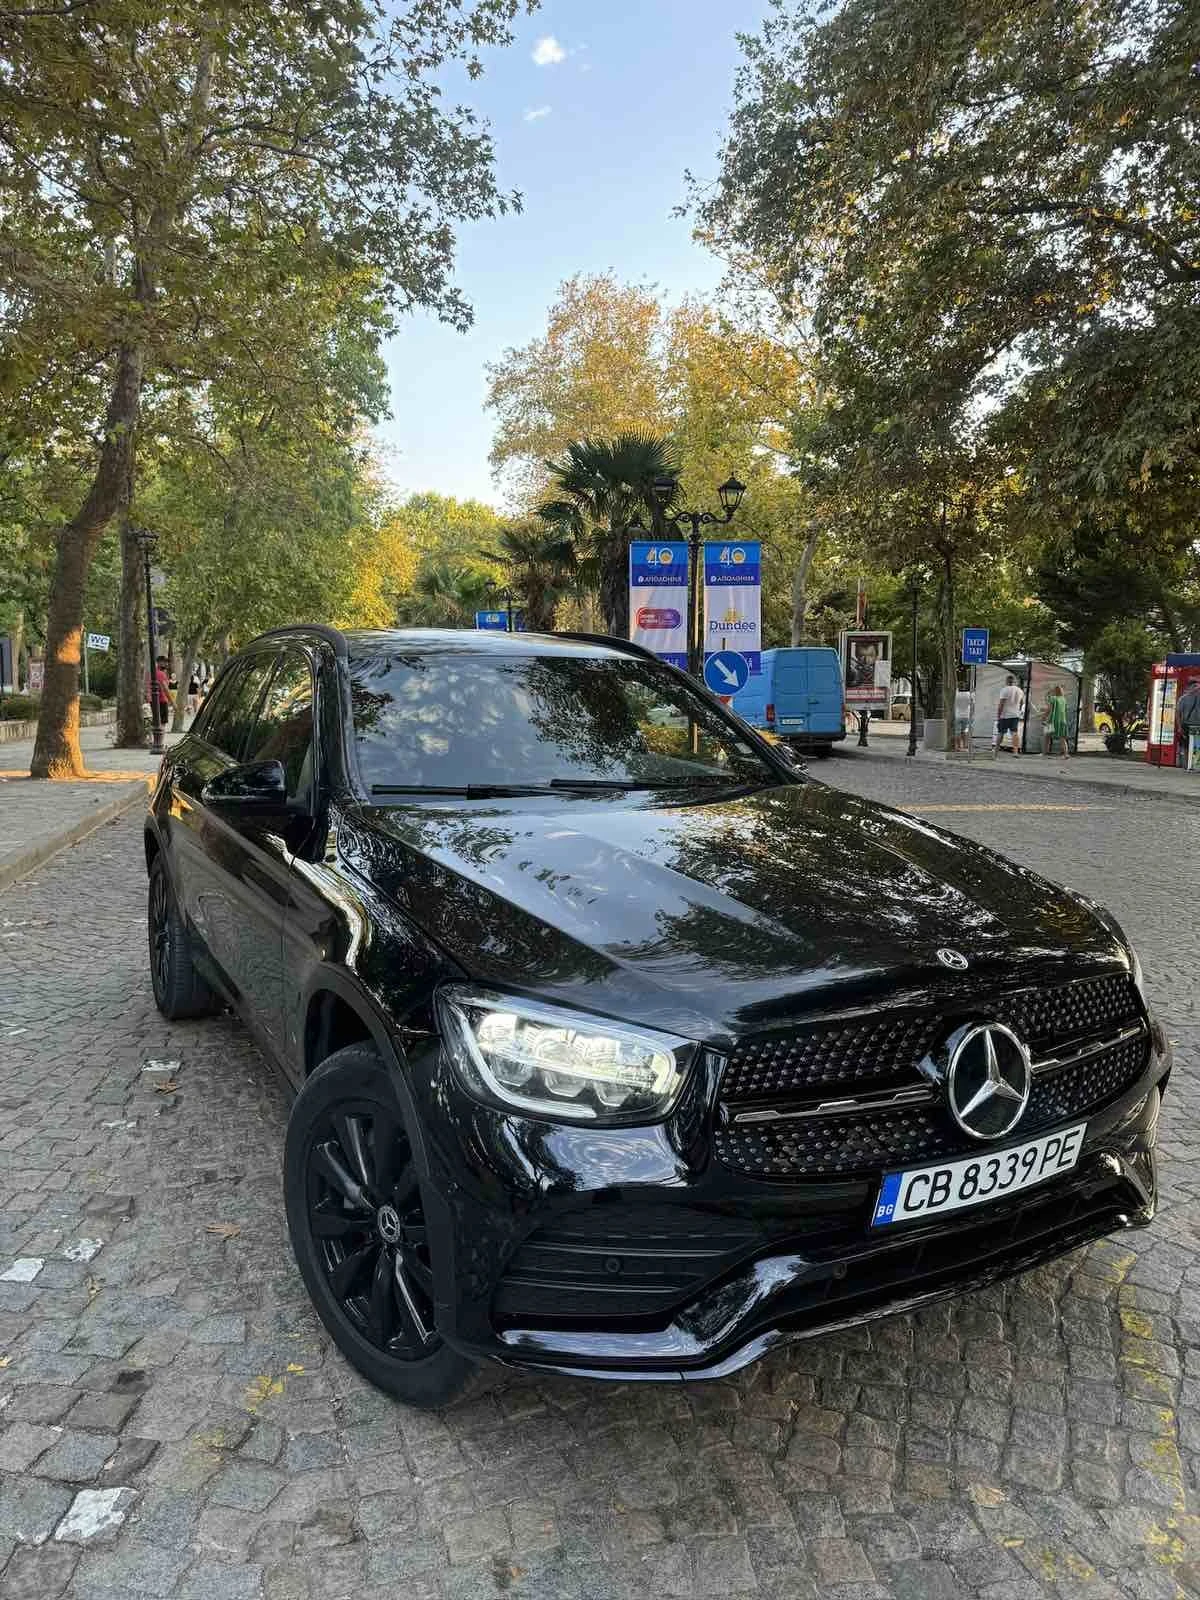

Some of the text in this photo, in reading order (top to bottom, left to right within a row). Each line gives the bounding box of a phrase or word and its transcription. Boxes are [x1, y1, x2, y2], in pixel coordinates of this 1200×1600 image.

[646, 546, 674, 566] 40
[719, 546, 746, 566] 40
[710, 620, 757, 631] Dundee
[90, 635, 108, 645] WC
[903, 1130, 1081, 1212] CB 8339 PE
[877, 1203, 893, 1217] BG
